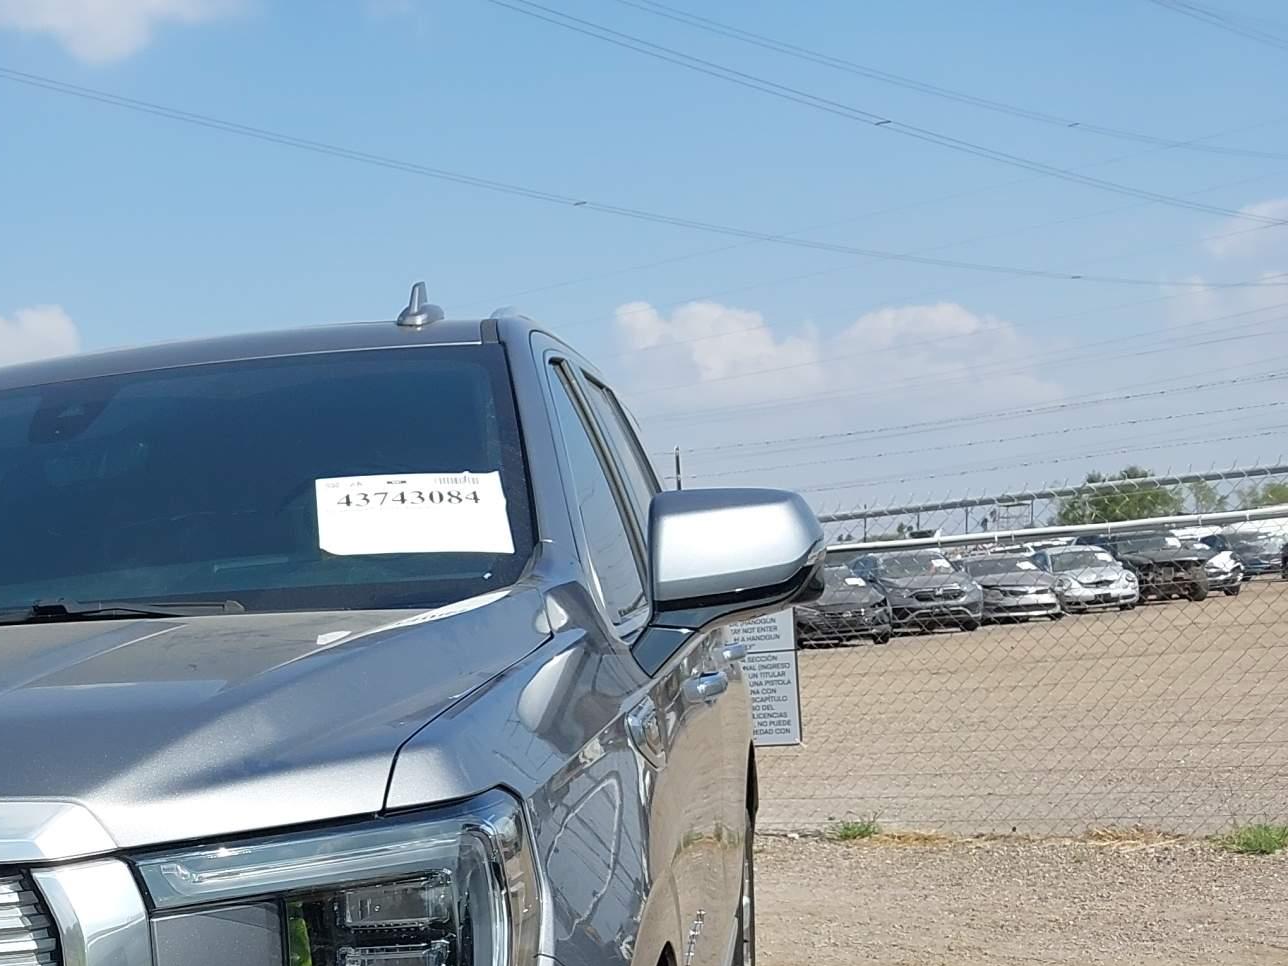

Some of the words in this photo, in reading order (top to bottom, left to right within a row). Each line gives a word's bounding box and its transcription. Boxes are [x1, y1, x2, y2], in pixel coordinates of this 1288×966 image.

[337, 490, 480, 507] 43743084
[757, 625, 778, 633] ENTER
[747, 655, 778, 663] SECCIÓN
[760, 671, 786, 679] TITULAR
[749, 680, 763, 688] UNA
[761, 687, 776, 695] CON
[769, 719, 792, 727] PUEDE
[775, 727, 791, 735] CON
